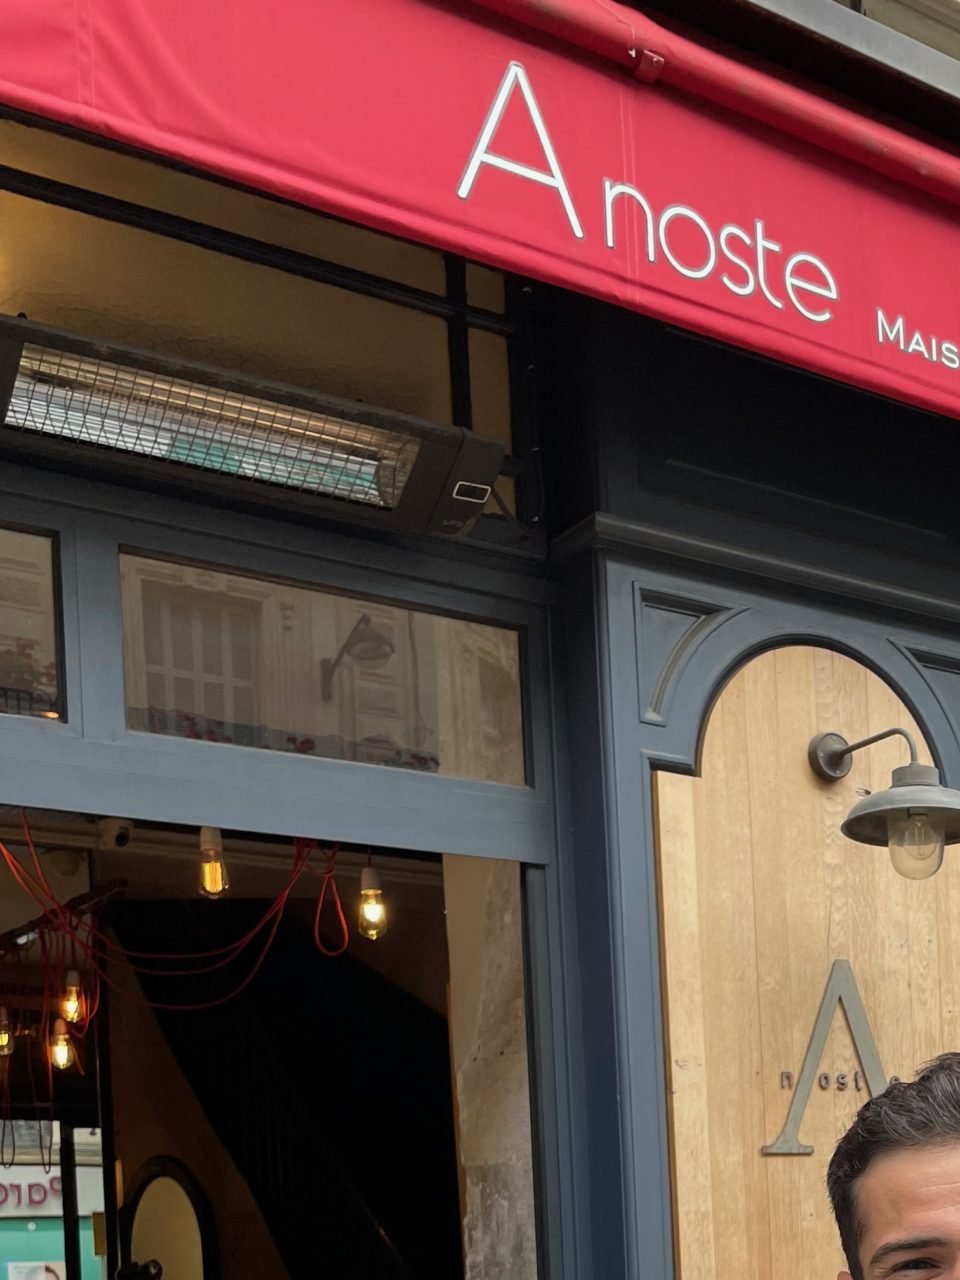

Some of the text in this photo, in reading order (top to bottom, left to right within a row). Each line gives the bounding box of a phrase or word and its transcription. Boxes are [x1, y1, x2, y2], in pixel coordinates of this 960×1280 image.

[456, 59, 840, 324] A noste
[761, 958, 888, 1156] A
